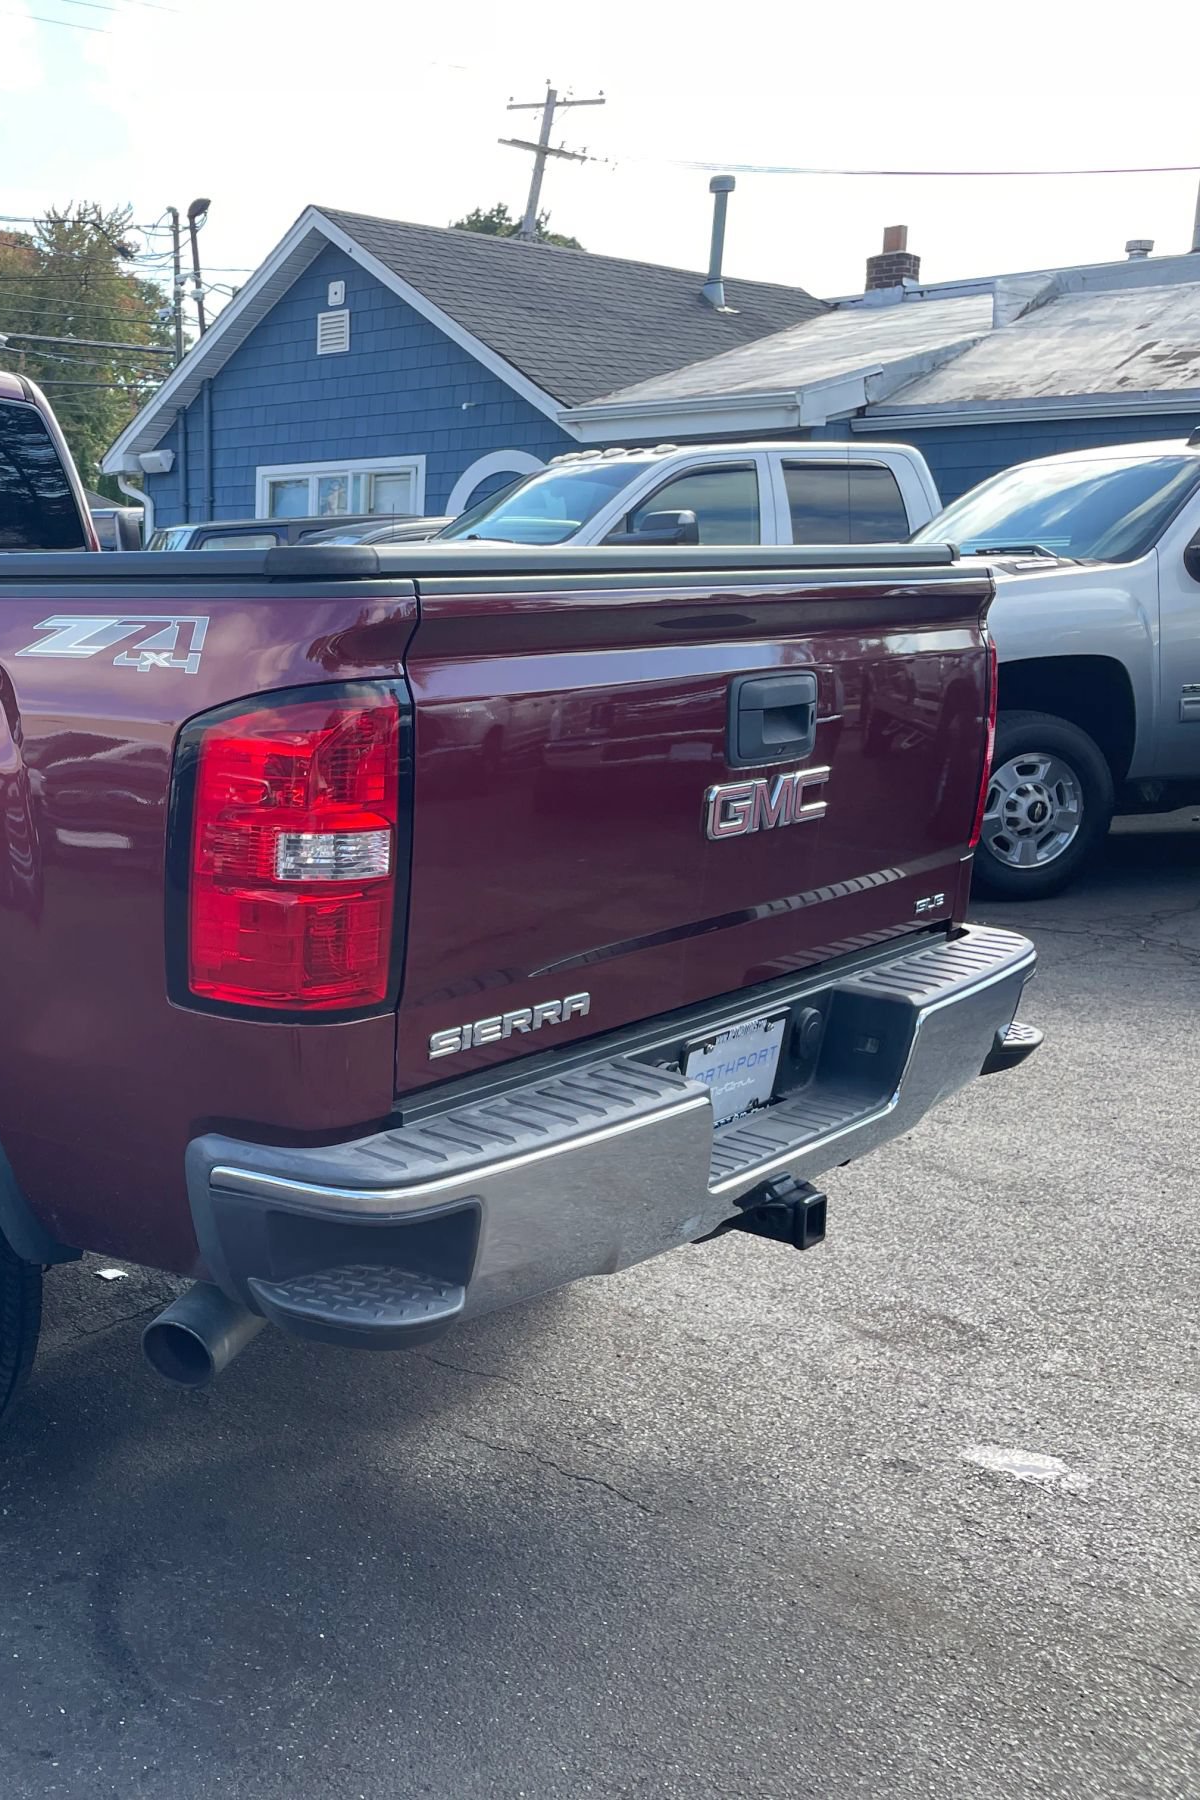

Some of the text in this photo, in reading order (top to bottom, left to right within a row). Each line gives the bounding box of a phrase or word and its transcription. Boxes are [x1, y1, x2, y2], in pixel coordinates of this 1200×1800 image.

[15, 615, 209, 658] Z71
[705, 765, 831, 840] GMC
[429, 992, 590, 1060] SIERRA
[688, 1045, 779, 1083] ORTHPORT
